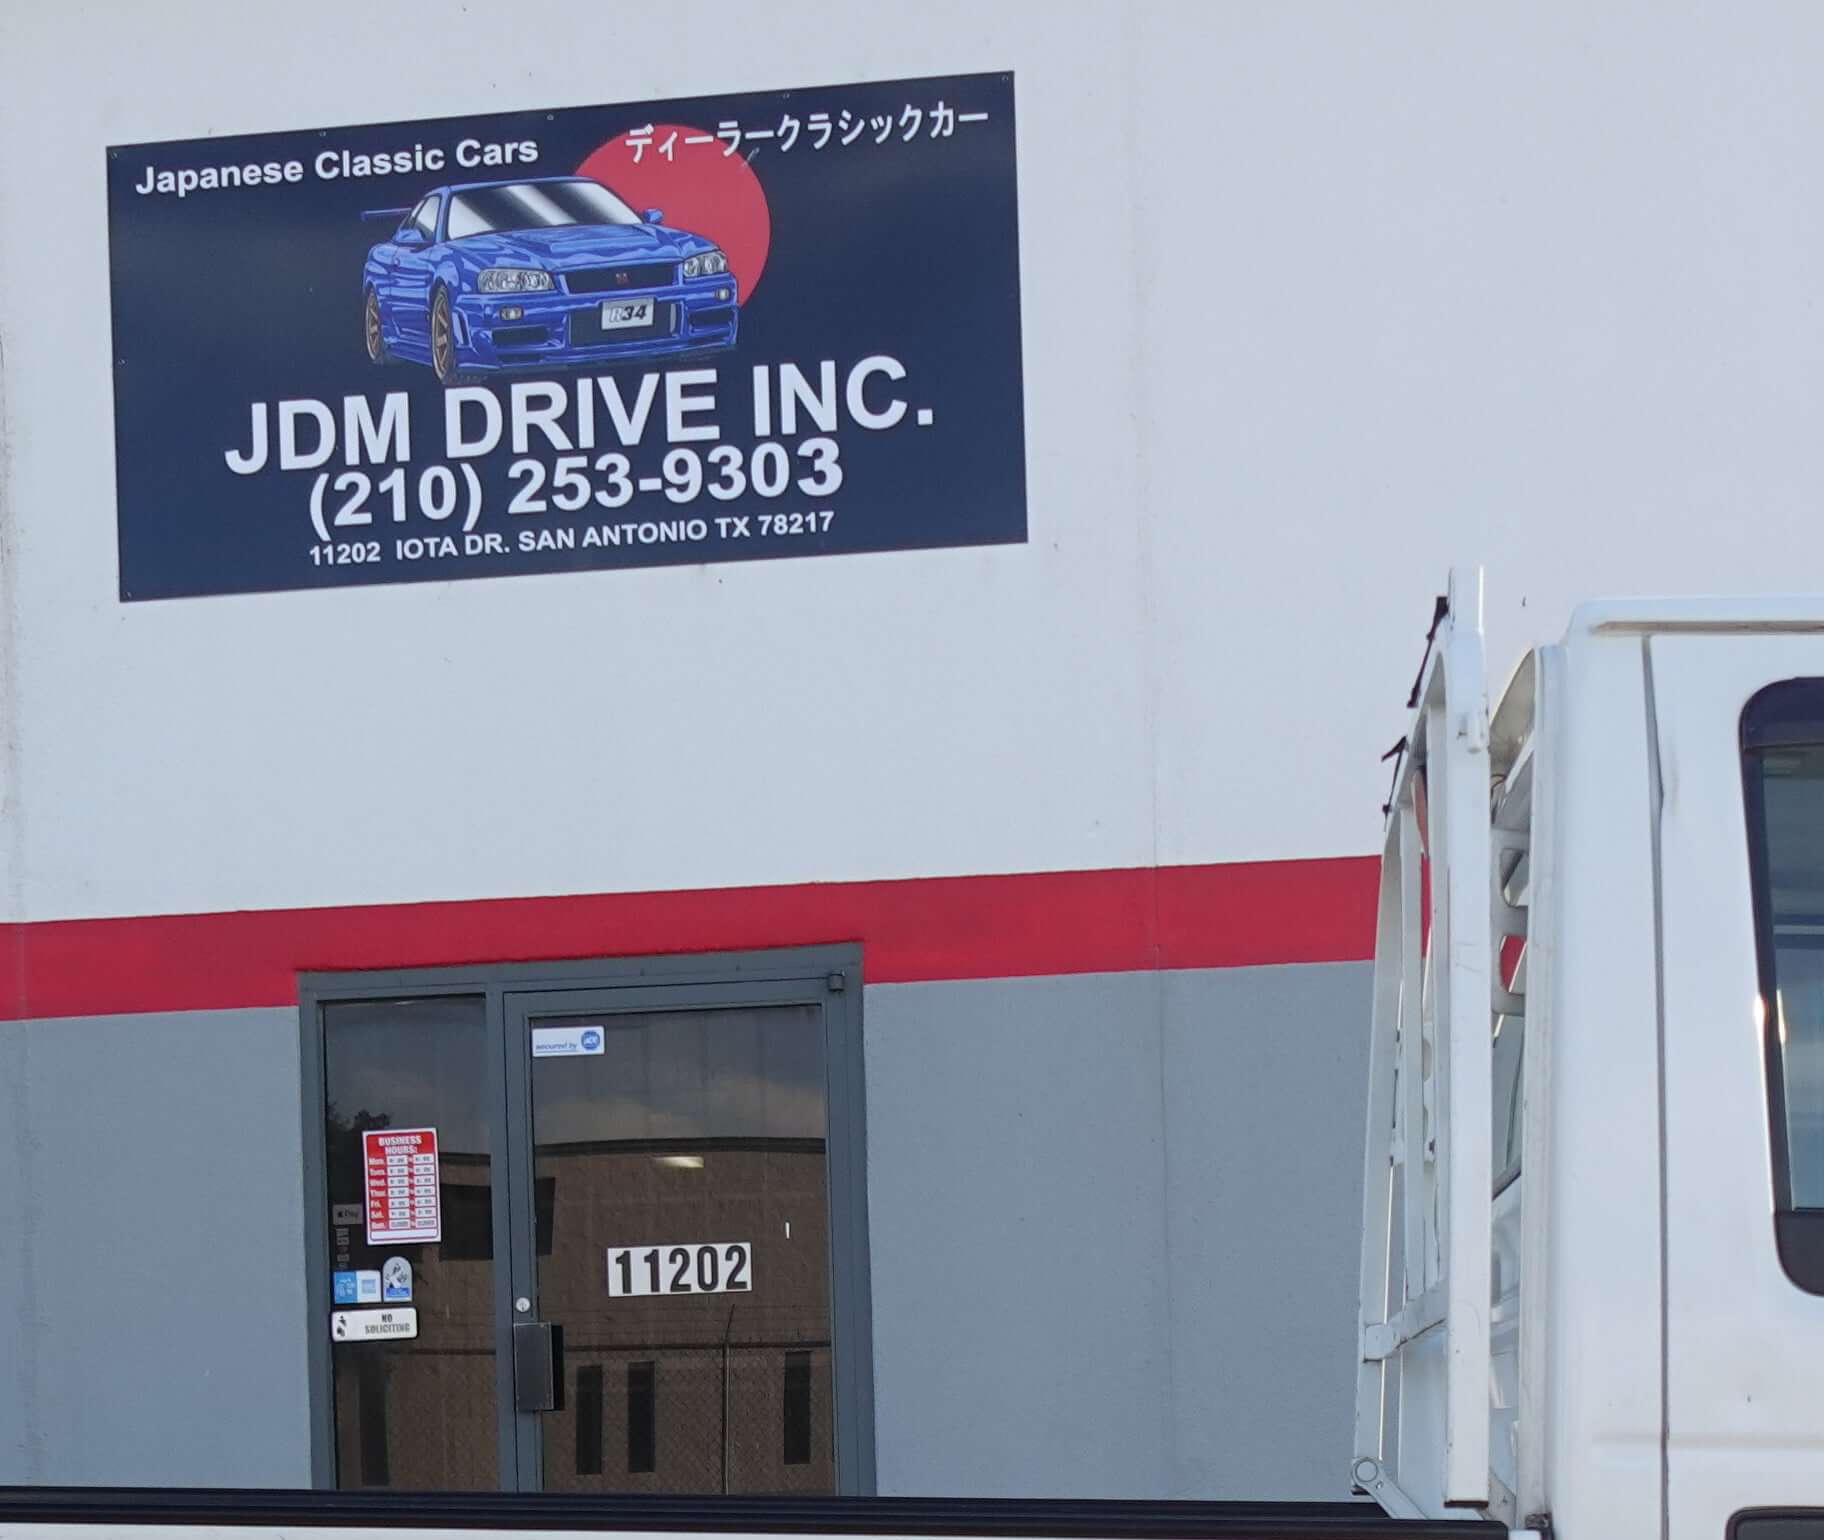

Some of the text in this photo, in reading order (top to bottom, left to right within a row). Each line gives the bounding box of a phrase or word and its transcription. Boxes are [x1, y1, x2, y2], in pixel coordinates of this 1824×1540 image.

[625, 101, 989, 163] ディーラークラシックカー
[135, 140, 539, 198] Japanese Classic Cars
[609, 304, 648, 323] R34
[225, 355, 935, 475] JDM DRIVE INC.
[310, 437, 844, 542] (210) 253-9303
[309, 511, 835, 567] 11202 IOTA DR. SAN ANTONIO TX 78217
[378, 1135, 422, 1147] BUSINESS
[615, 1245, 748, 1295] 11202
[381, 1313, 393, 1322] NO
